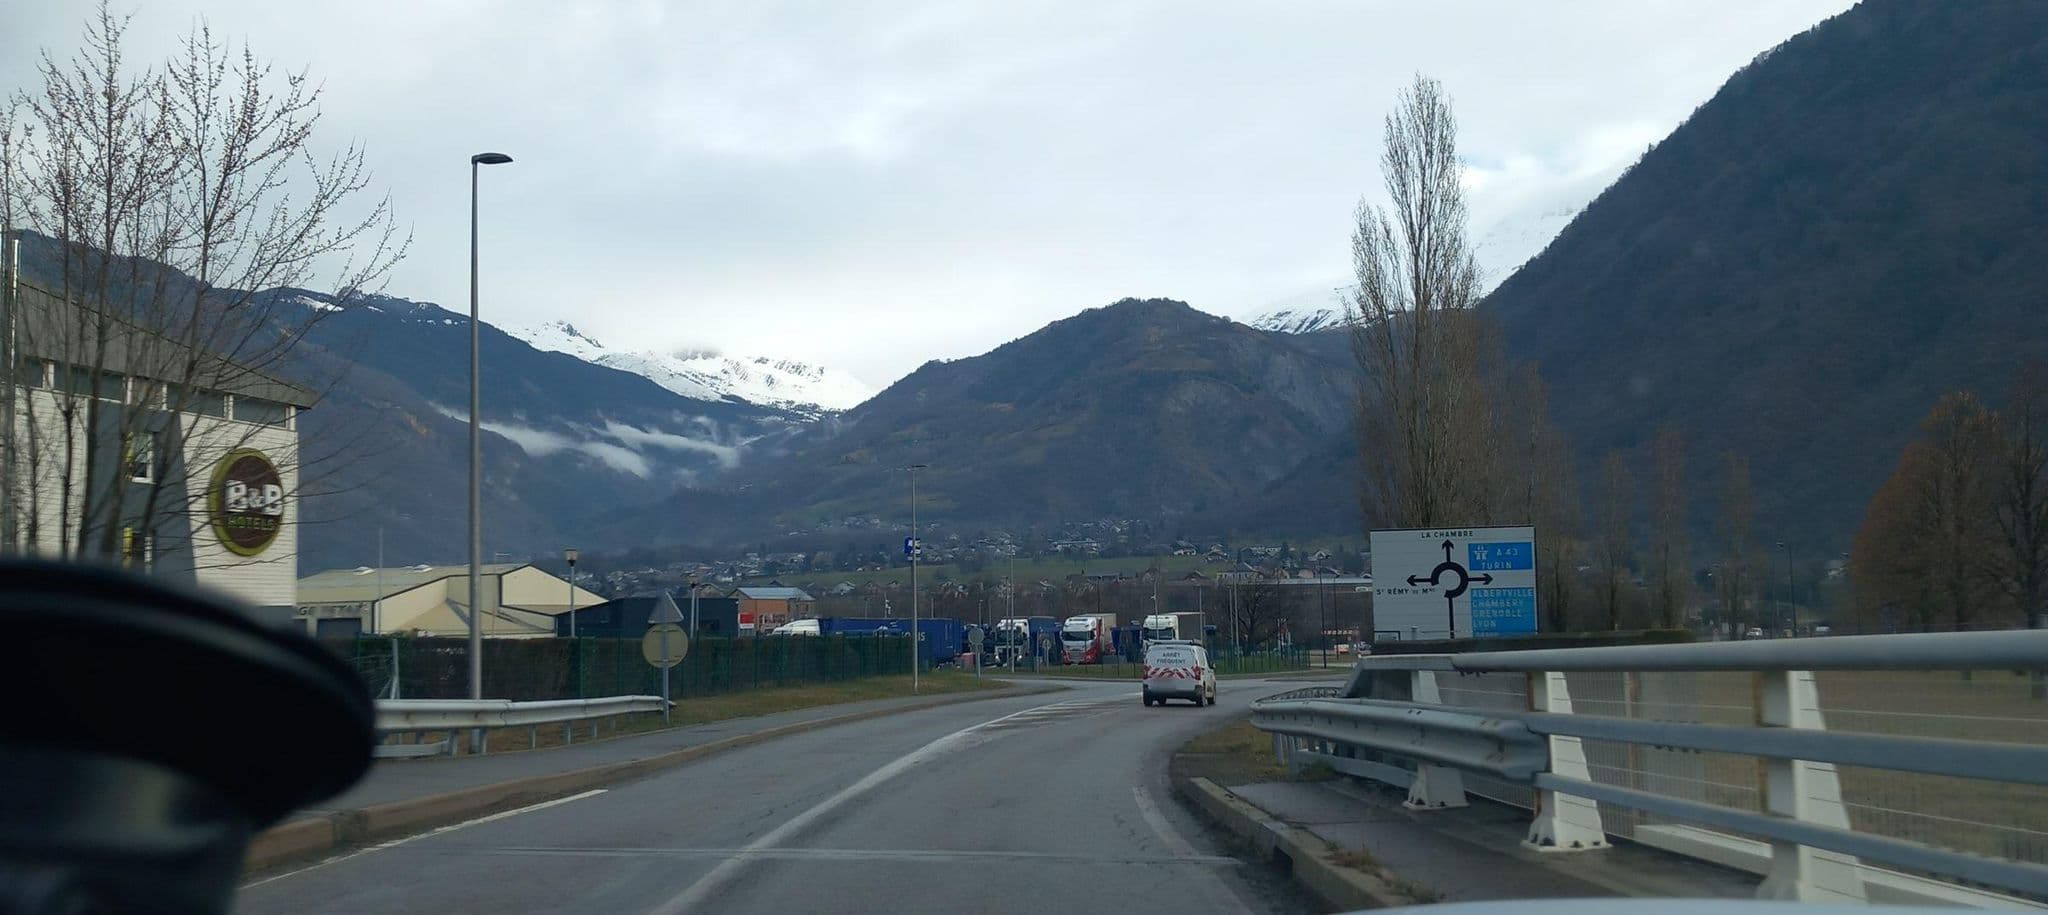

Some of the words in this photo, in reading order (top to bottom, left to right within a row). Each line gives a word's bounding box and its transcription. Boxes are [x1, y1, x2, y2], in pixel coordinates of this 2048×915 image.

[225, 480, 283, 515] B&B
[227, 516, 276, 530] HOTELS
[1434, 530, 1474, 538] CHAMBRE
[1496, 548, 1503, 556] A
[1481, 561, 1512, 569] TURIN
[1472, 588, 1534, 598] ALBERTVILLE
[1472, 609, 1522, 618] GRENOBLE
[1473, 619, 1497, 628] LYON
